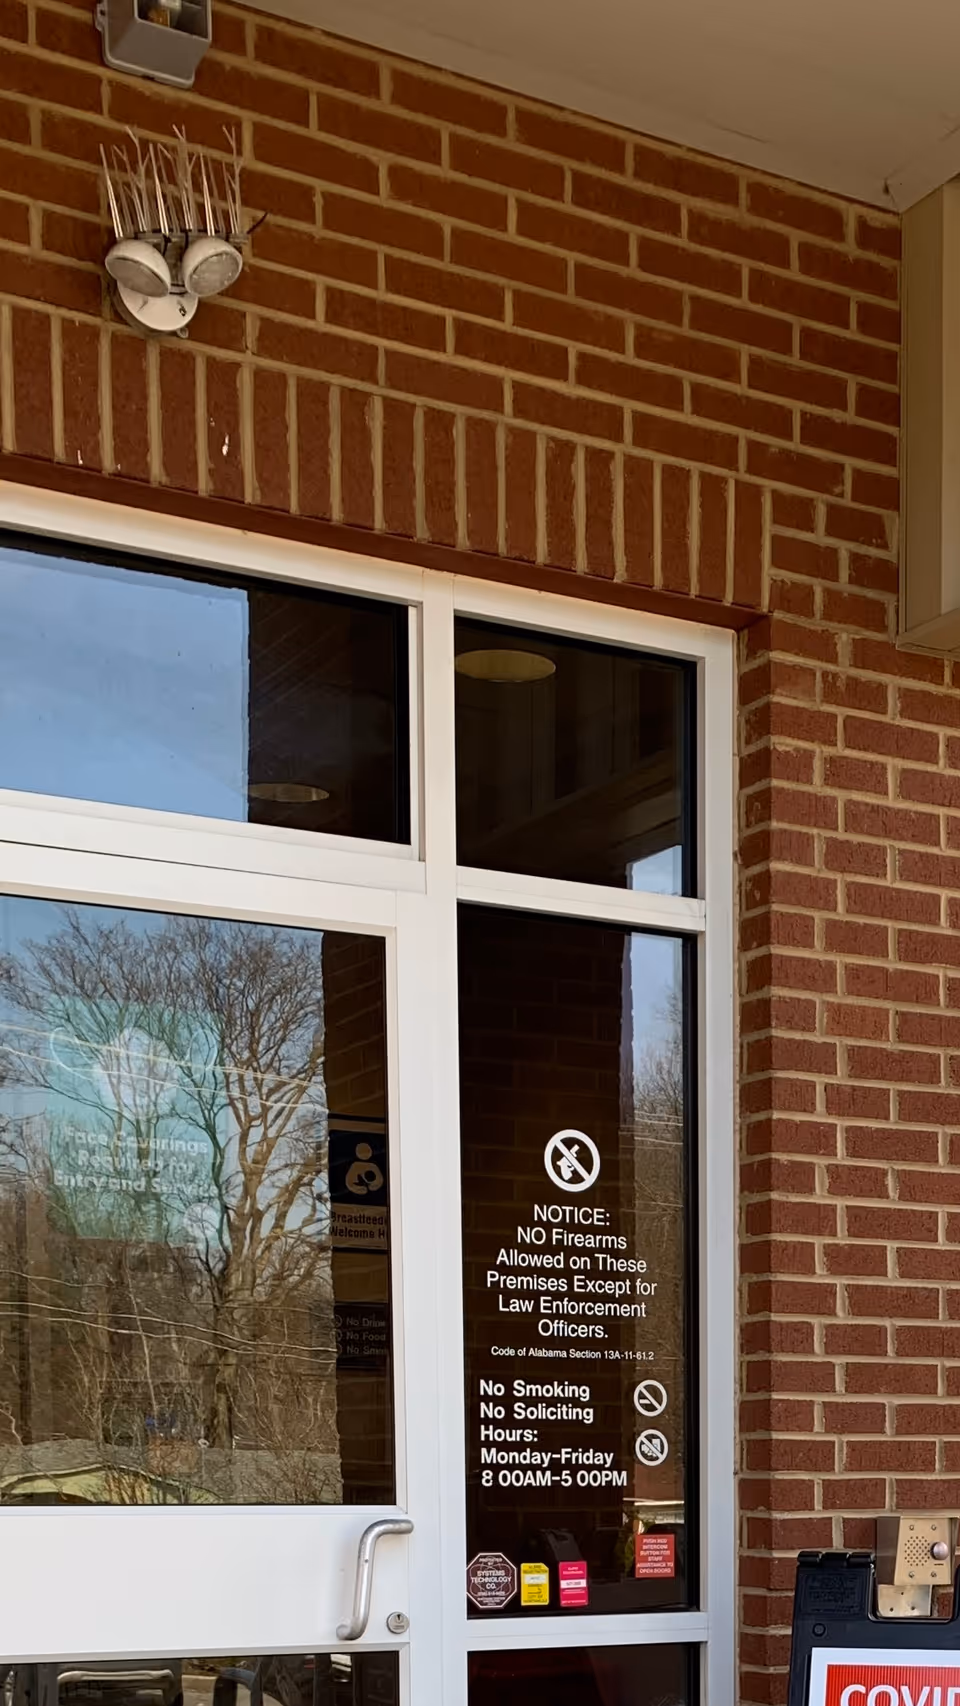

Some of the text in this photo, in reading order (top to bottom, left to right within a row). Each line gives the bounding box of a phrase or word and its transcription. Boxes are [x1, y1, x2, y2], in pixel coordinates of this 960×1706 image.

[77, 1150, 195, 1174] Required for
[53, 1168, 104, 1193] Entry
[108, 1176, 146, 1193] and
[533, 1204, 611, 1226] NOTICE:
[517, 1226, 628, 1250] NO Firearms
[496, 1248, 648, 1274] Allowed on These
[486, 1270, 658, 1298] Premises Except for
[498, 1294, 647, 1318] Law Enforcement
[537, 1318, 609, 1339] Officers.
[490, 1345, 655, 1361] Code of Alabama Section 13A-11-61.2
[479, 1378, 591, 1402] No Smoking
[479, 1401, 595, 1425] No Soliciting
[480, 1424, 539, 1443] Hours:
[480, 1447, 614, 1468] Monday-Friday
